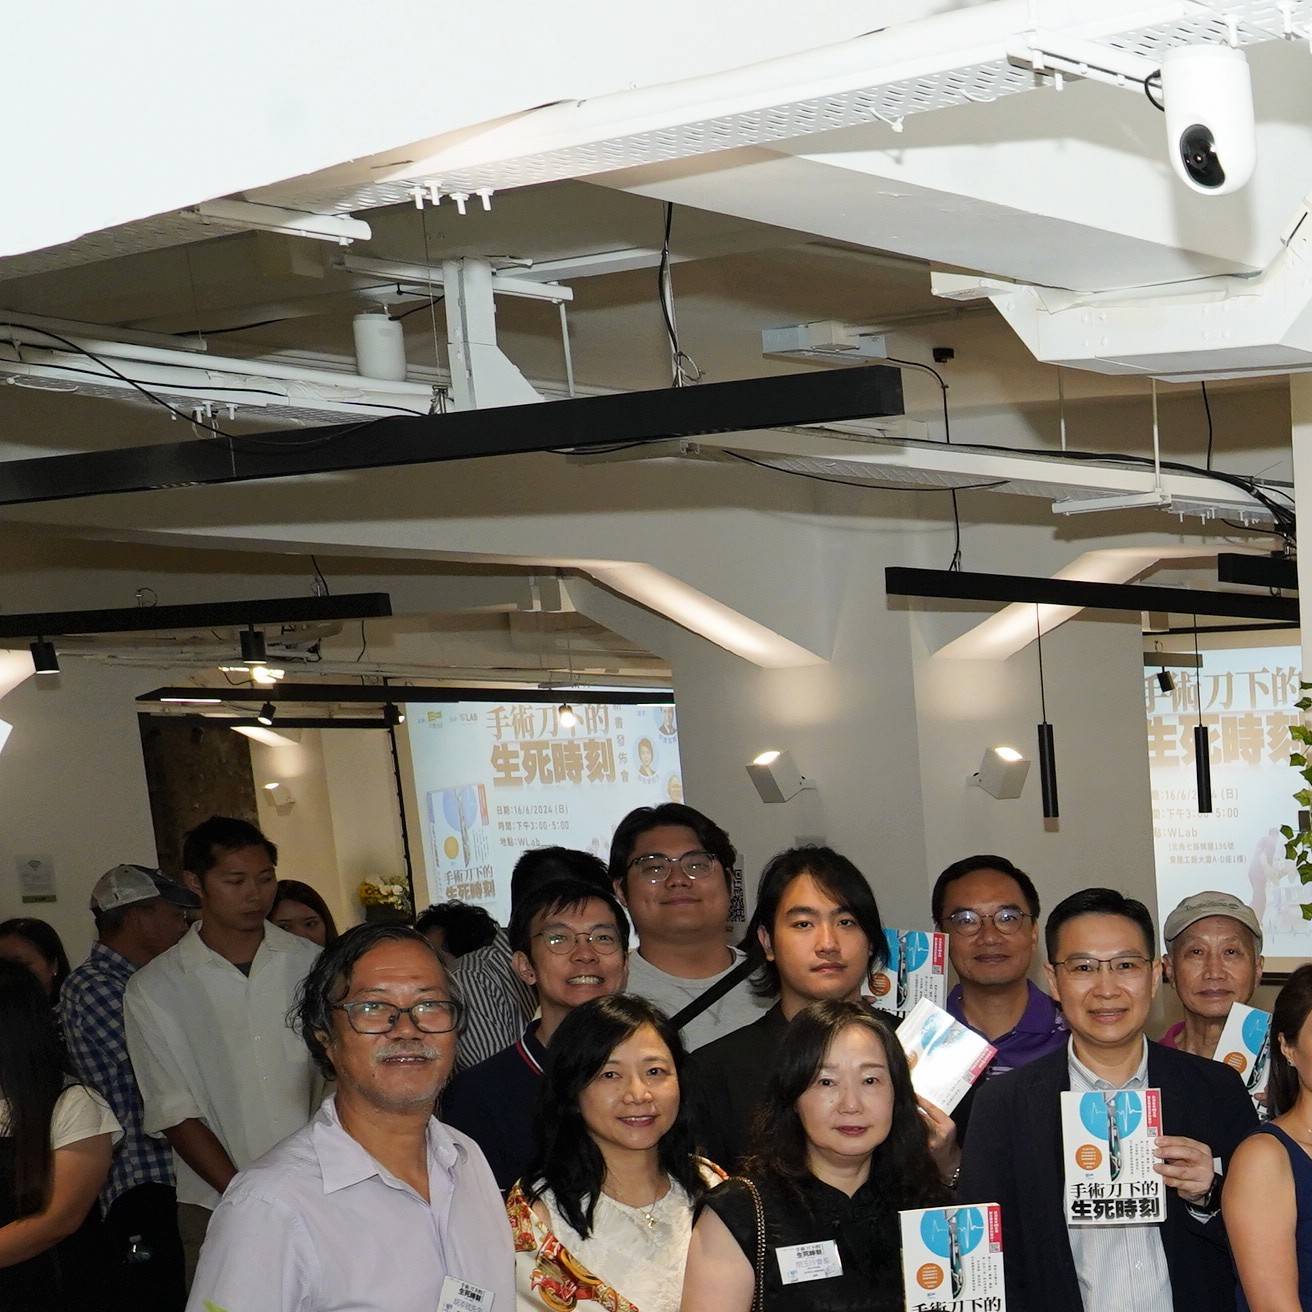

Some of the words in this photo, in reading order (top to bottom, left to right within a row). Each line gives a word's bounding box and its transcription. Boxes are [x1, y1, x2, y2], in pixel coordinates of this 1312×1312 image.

[490, 738, 616, 786] 生死時刻
[1071, 1181, 1159, 1199] 手術刀下的
[1071, 1197, 1160, 1221] 生死時刻
